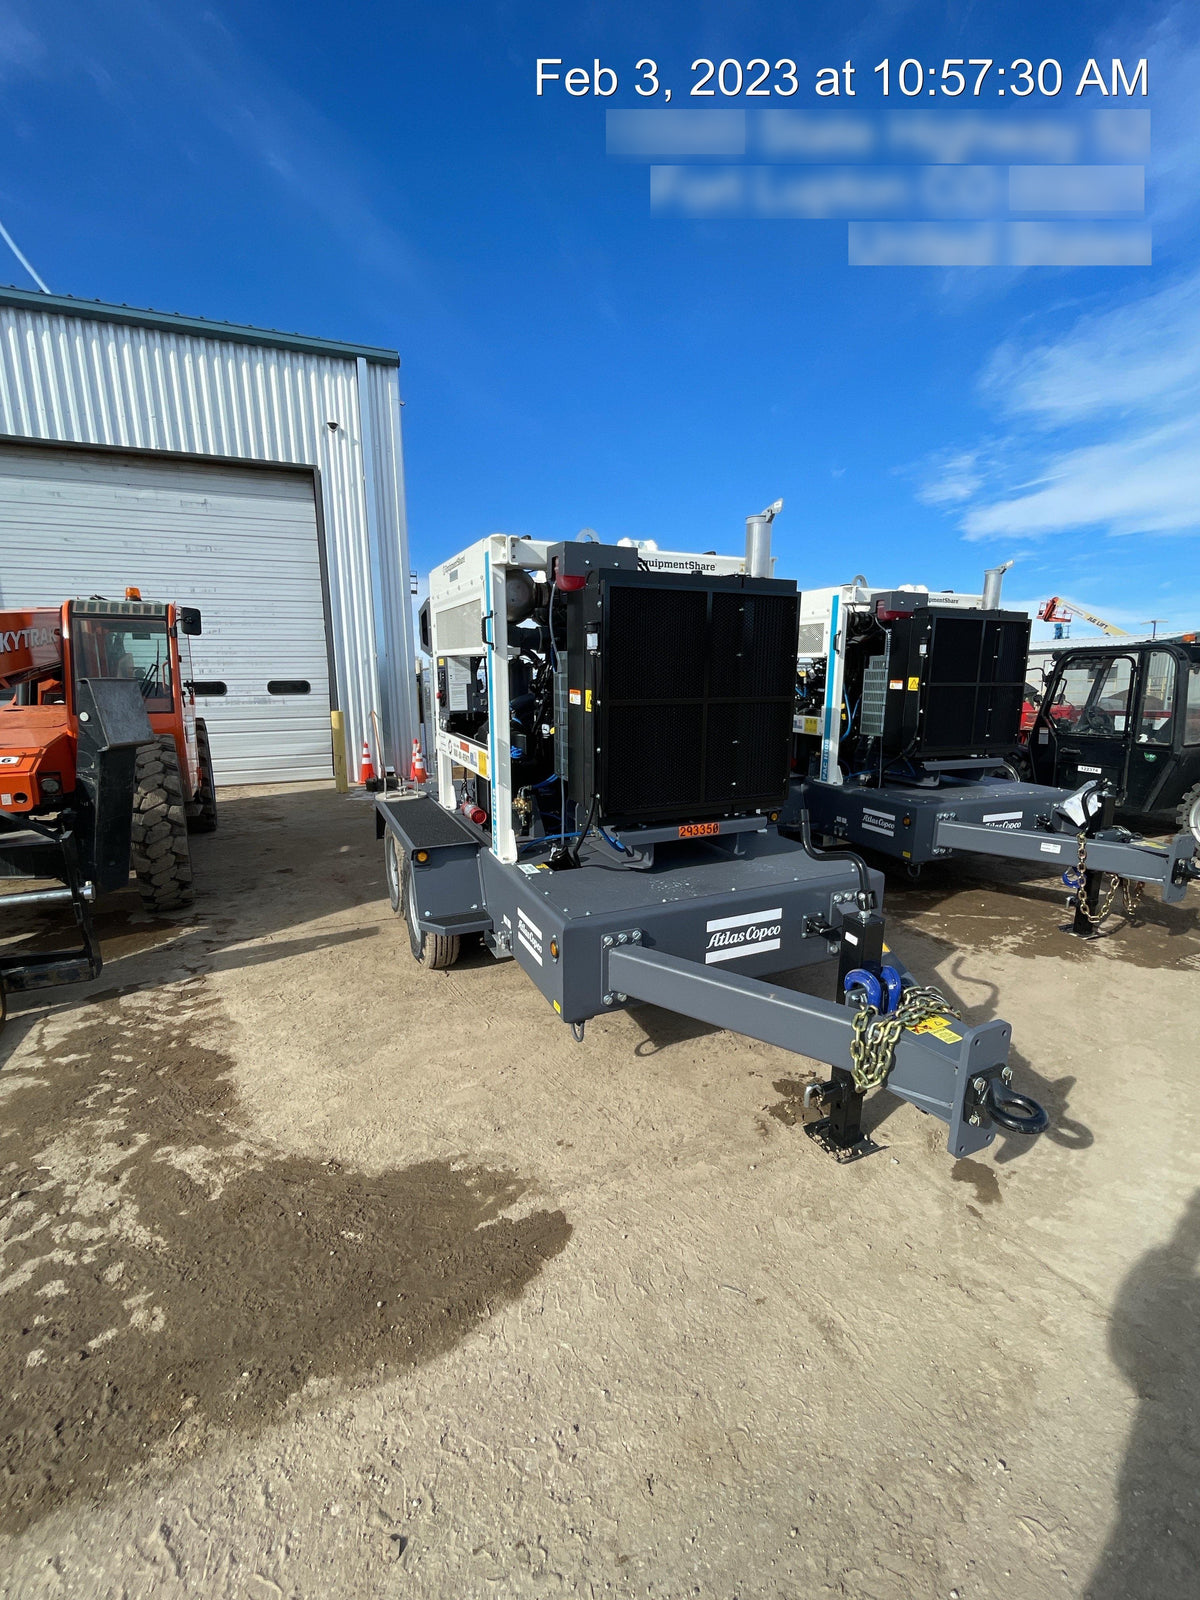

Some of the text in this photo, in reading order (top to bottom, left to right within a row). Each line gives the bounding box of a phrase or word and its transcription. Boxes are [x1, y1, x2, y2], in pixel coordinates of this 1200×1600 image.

[643, 559, 716, 571] uipmentShare
[0, 628, 59, 653] KYTRAK
[680, 823, 719, 837] 293350
[705, 925, 781, 949] Atlas Copco
